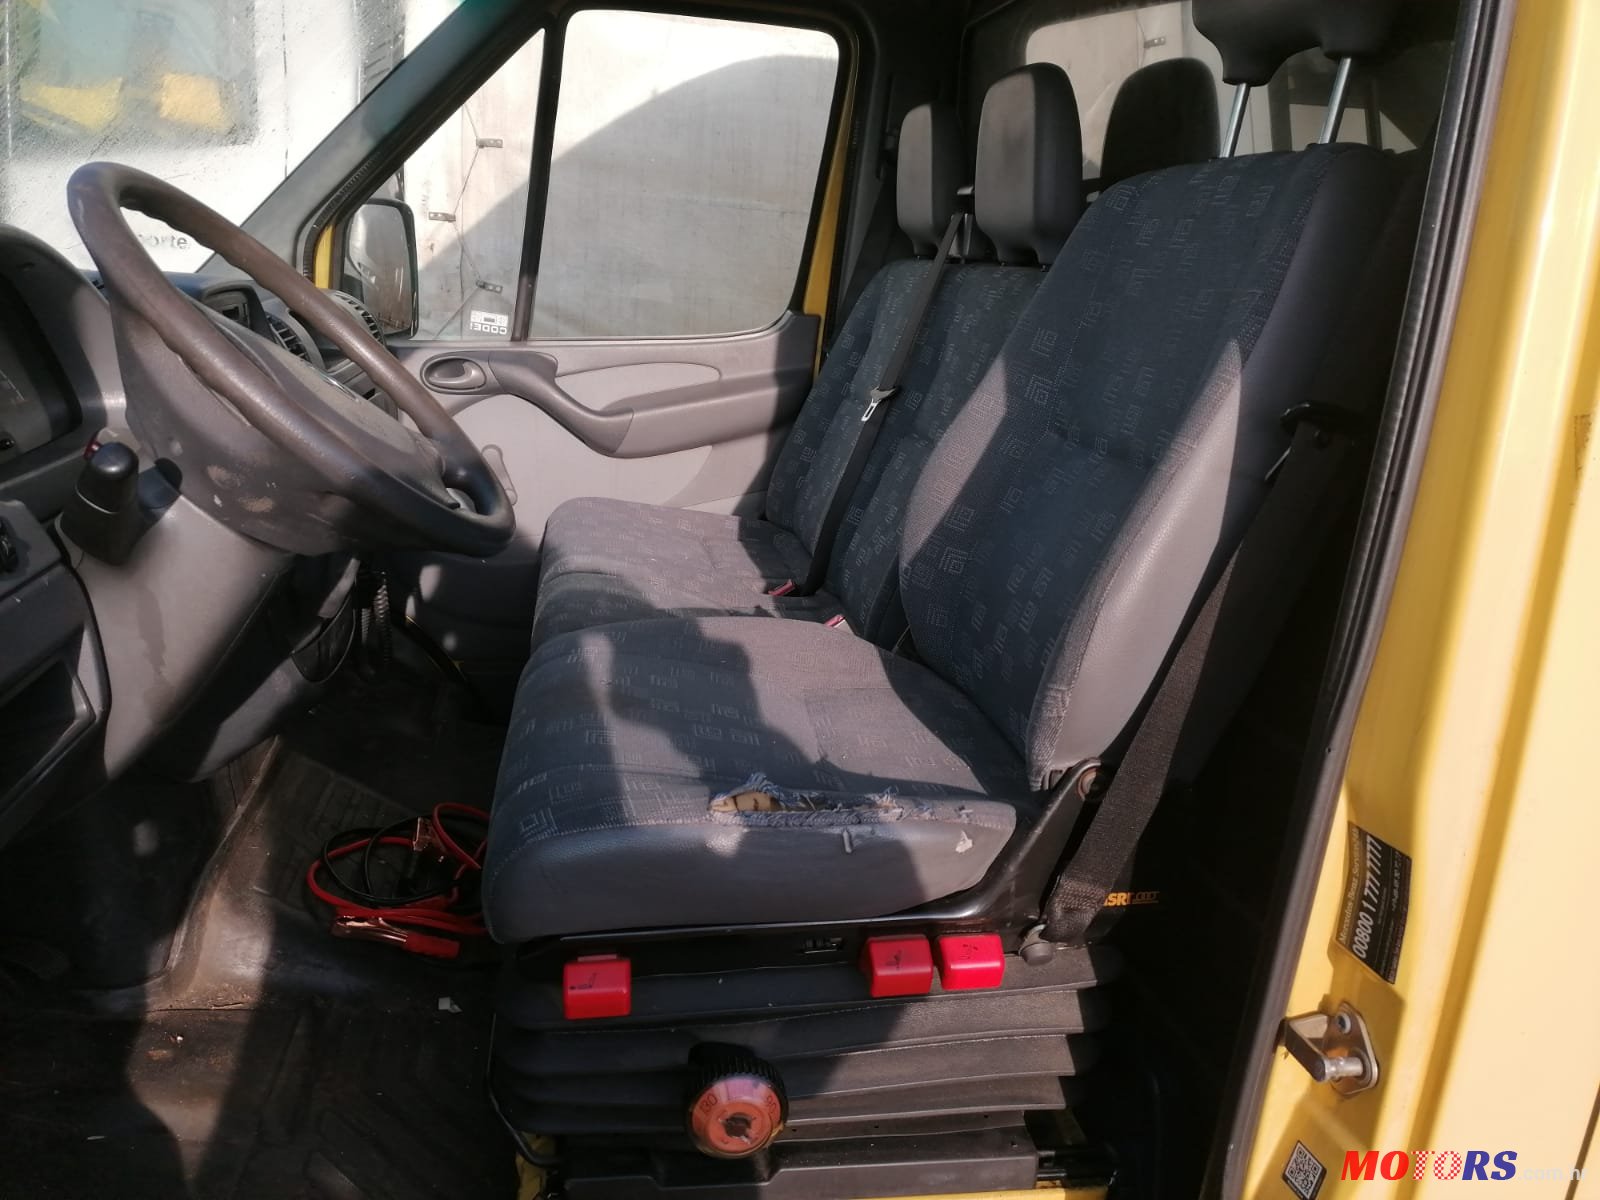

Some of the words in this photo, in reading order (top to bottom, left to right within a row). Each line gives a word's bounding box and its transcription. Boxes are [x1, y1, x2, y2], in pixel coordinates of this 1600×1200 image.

[1366, 835, 1382, 875] 7777
[1364, 873, 1380, 903] 777
[1362, 900, 1376, 912] 1
[1352, 911, 1374, 958] 00800
